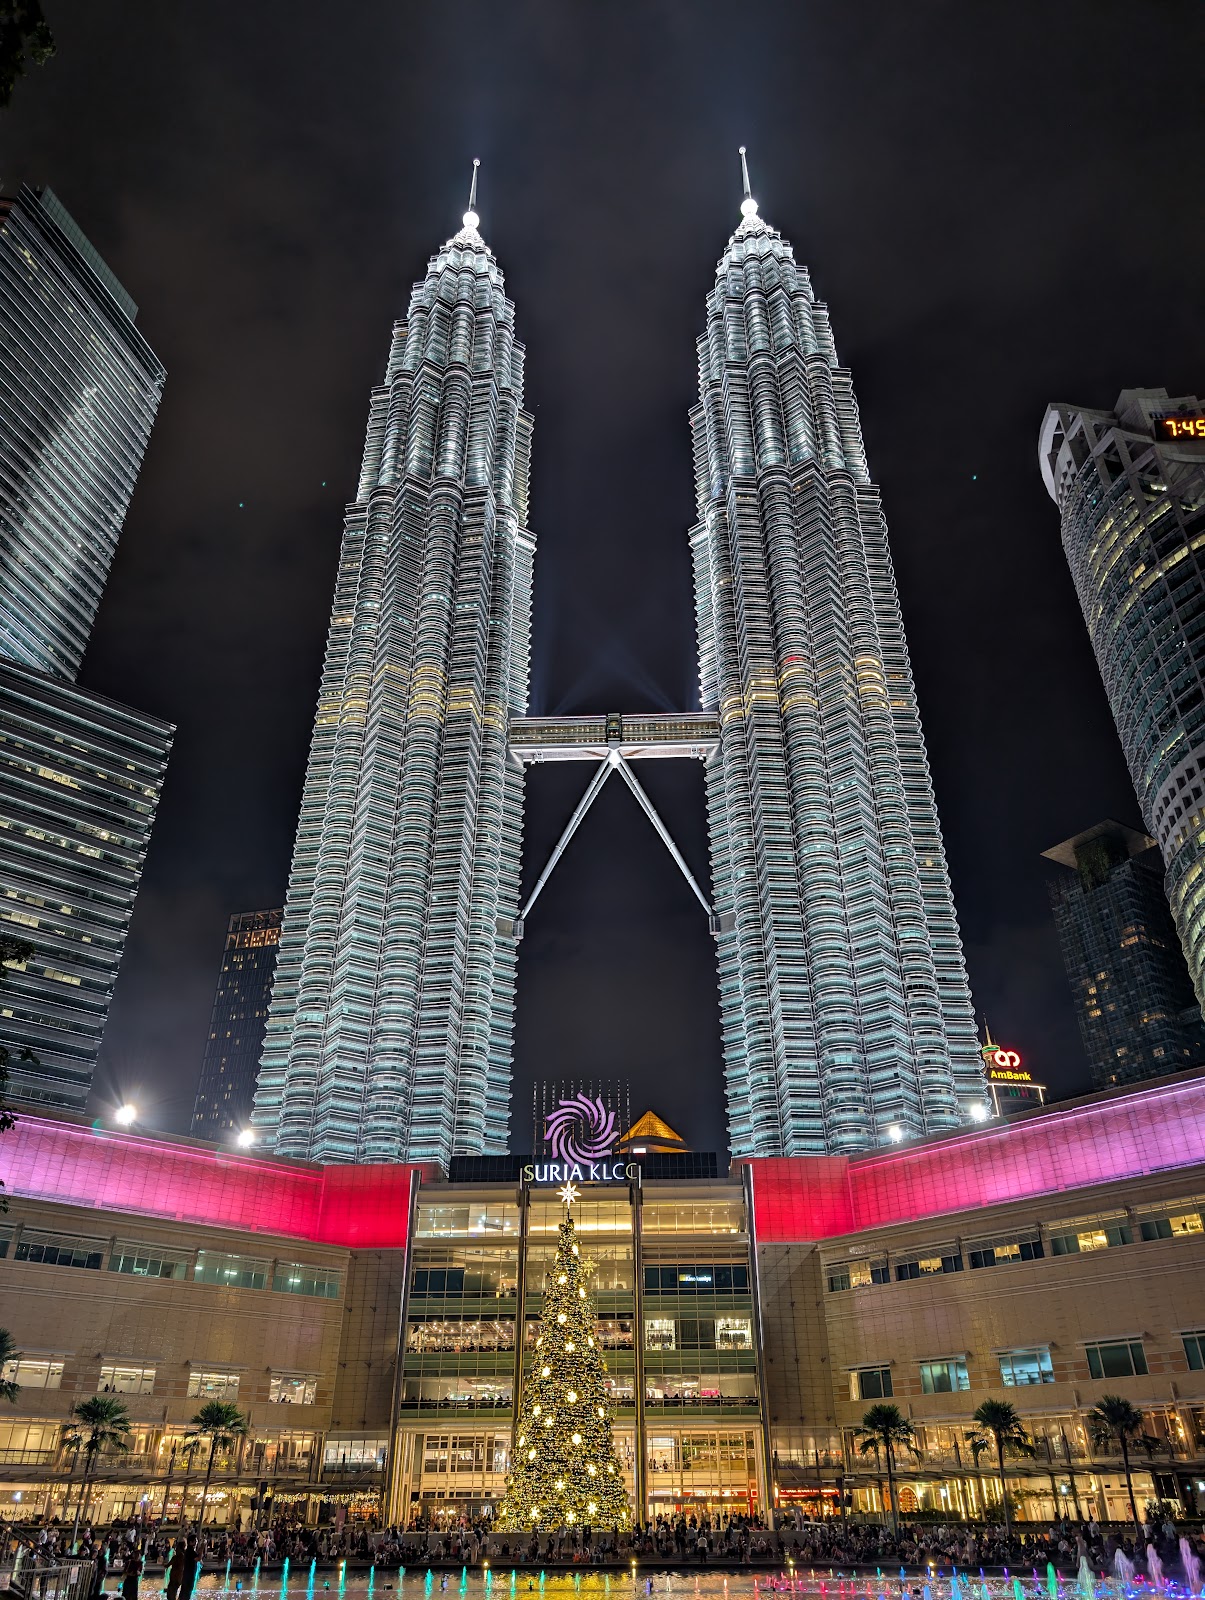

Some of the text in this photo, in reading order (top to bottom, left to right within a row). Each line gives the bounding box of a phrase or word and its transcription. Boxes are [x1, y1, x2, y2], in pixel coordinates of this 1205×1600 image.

[1165, 420, 1205, 437] 7:45
[990, 1070, 1032, 1081] AmBank
[523, 1162, 638, 1182] SURIA KLCC
